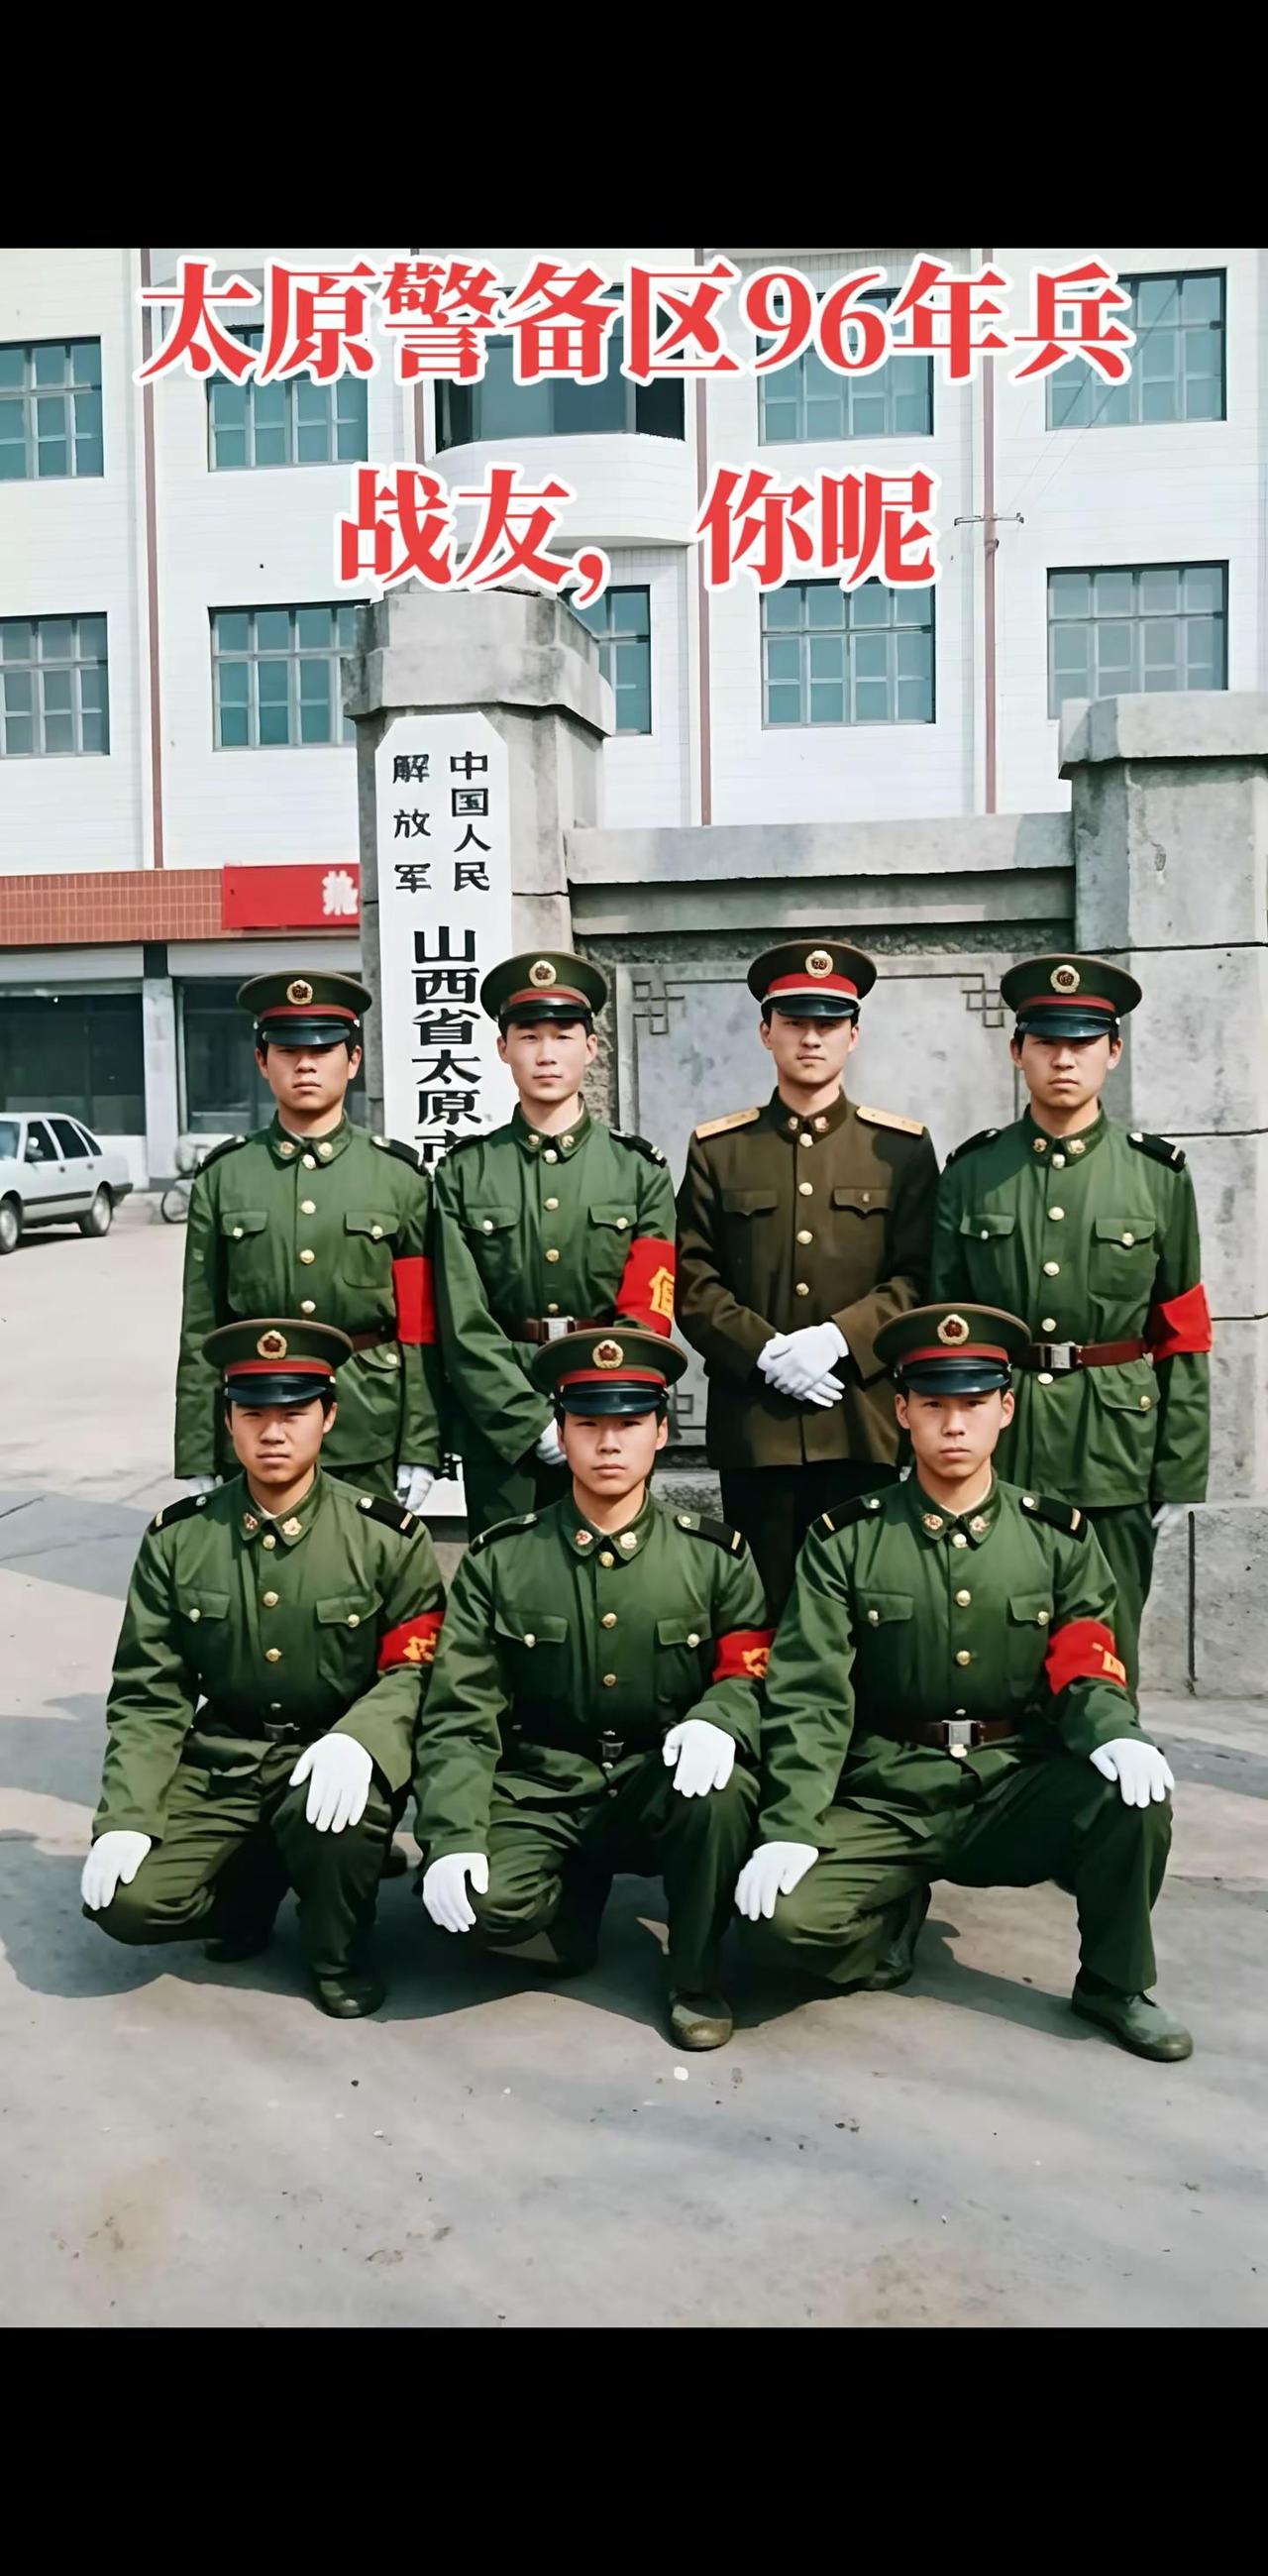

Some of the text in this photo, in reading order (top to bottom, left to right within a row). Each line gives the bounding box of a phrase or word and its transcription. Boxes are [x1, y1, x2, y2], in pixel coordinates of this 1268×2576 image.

[392, 754, 432, 894] 解放军
[450, 750, 491, 892] 中国人民
